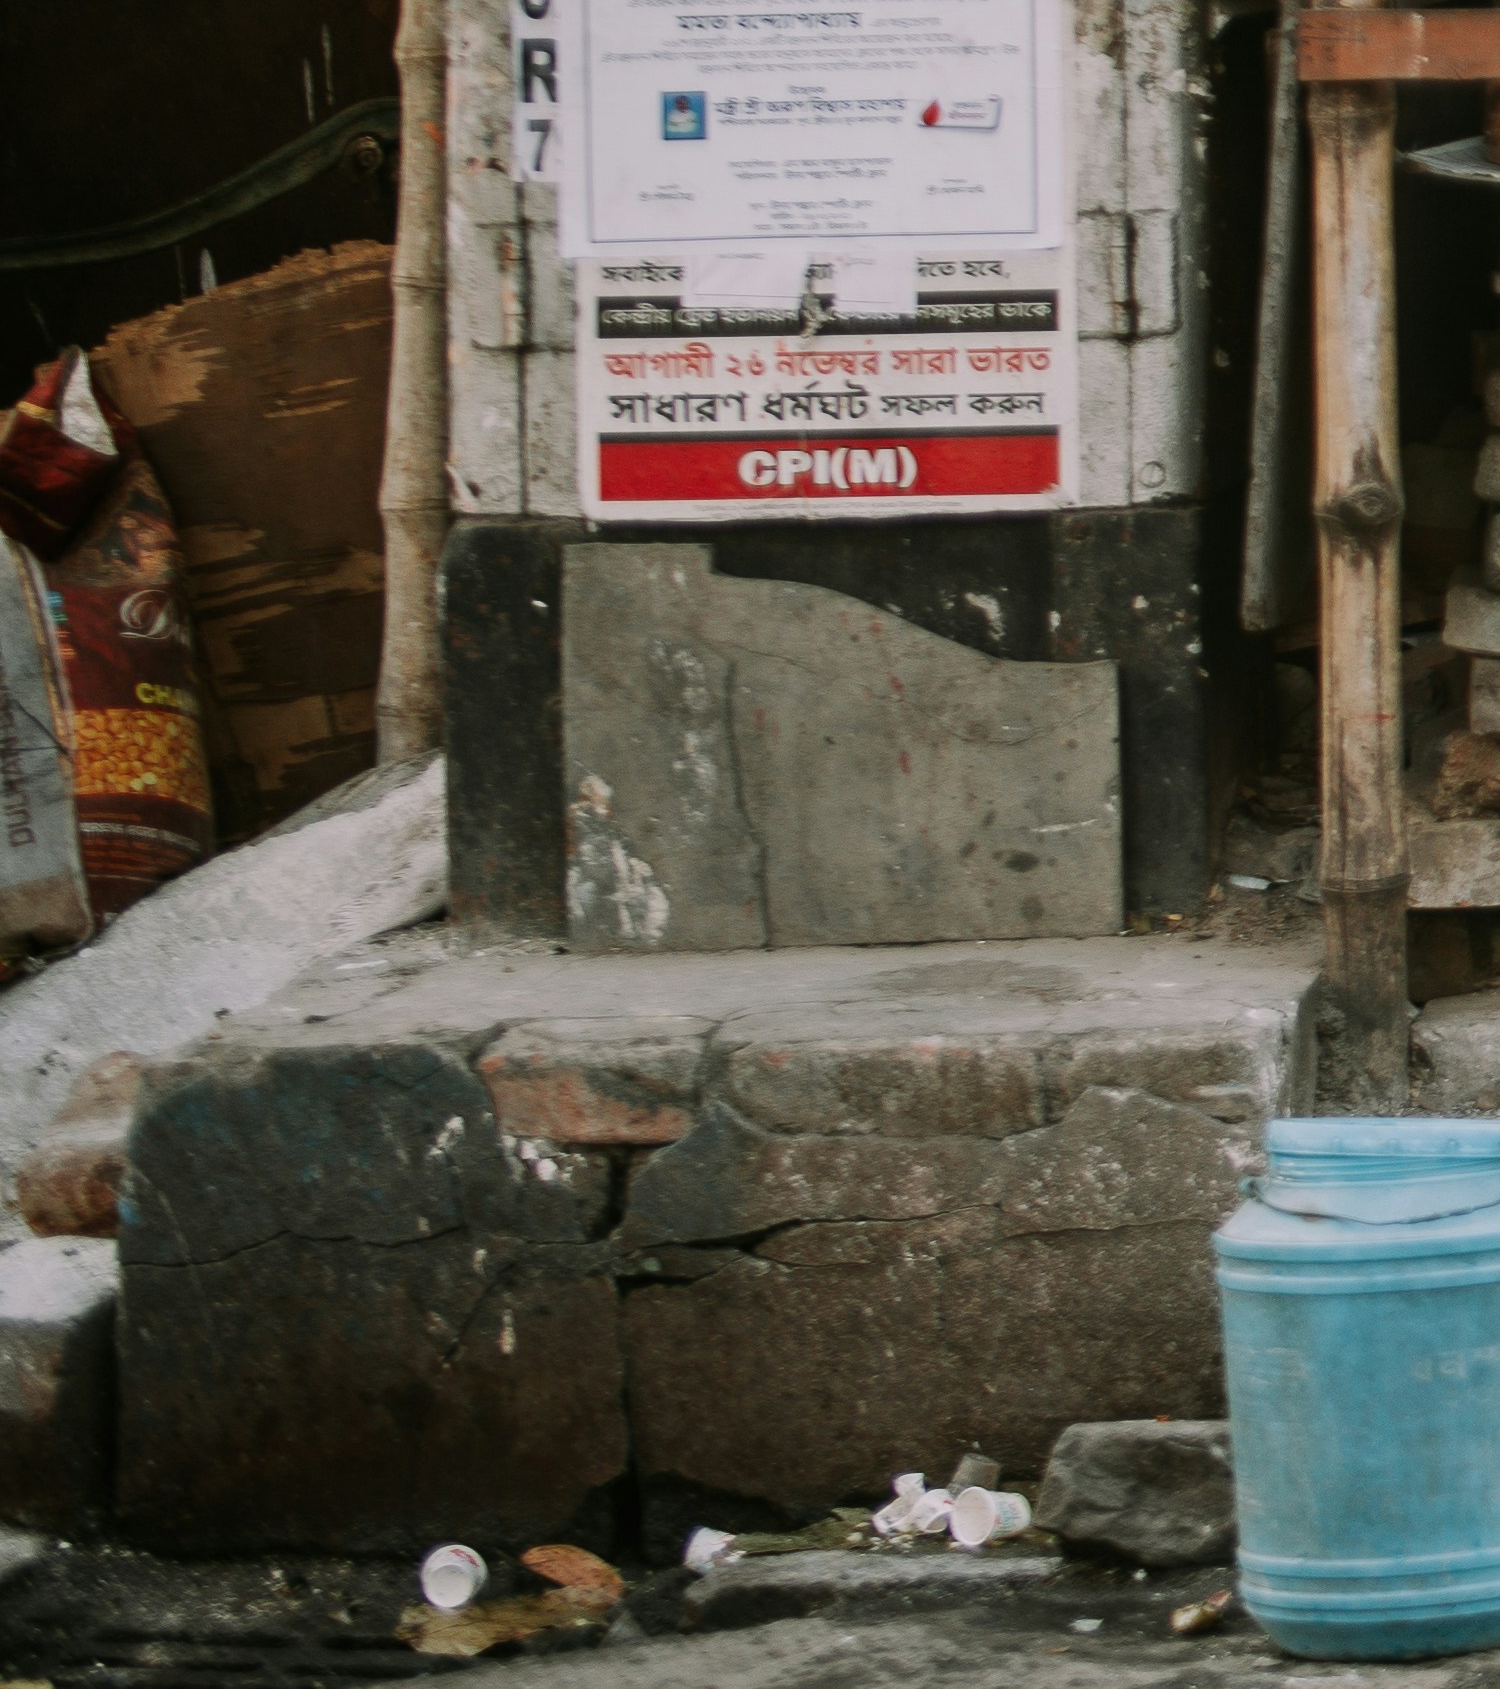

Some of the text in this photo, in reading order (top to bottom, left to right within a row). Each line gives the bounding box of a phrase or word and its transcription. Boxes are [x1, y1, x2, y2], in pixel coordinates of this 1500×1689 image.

[603, 342, 1052, 379] আগামী ২৬ নভেম্বর সারা ভারত
[608, 380, 1046, 424] সাধারণ ধর্মঘট সফল করুন
[736, 445, 918, 490] CPI(M)
